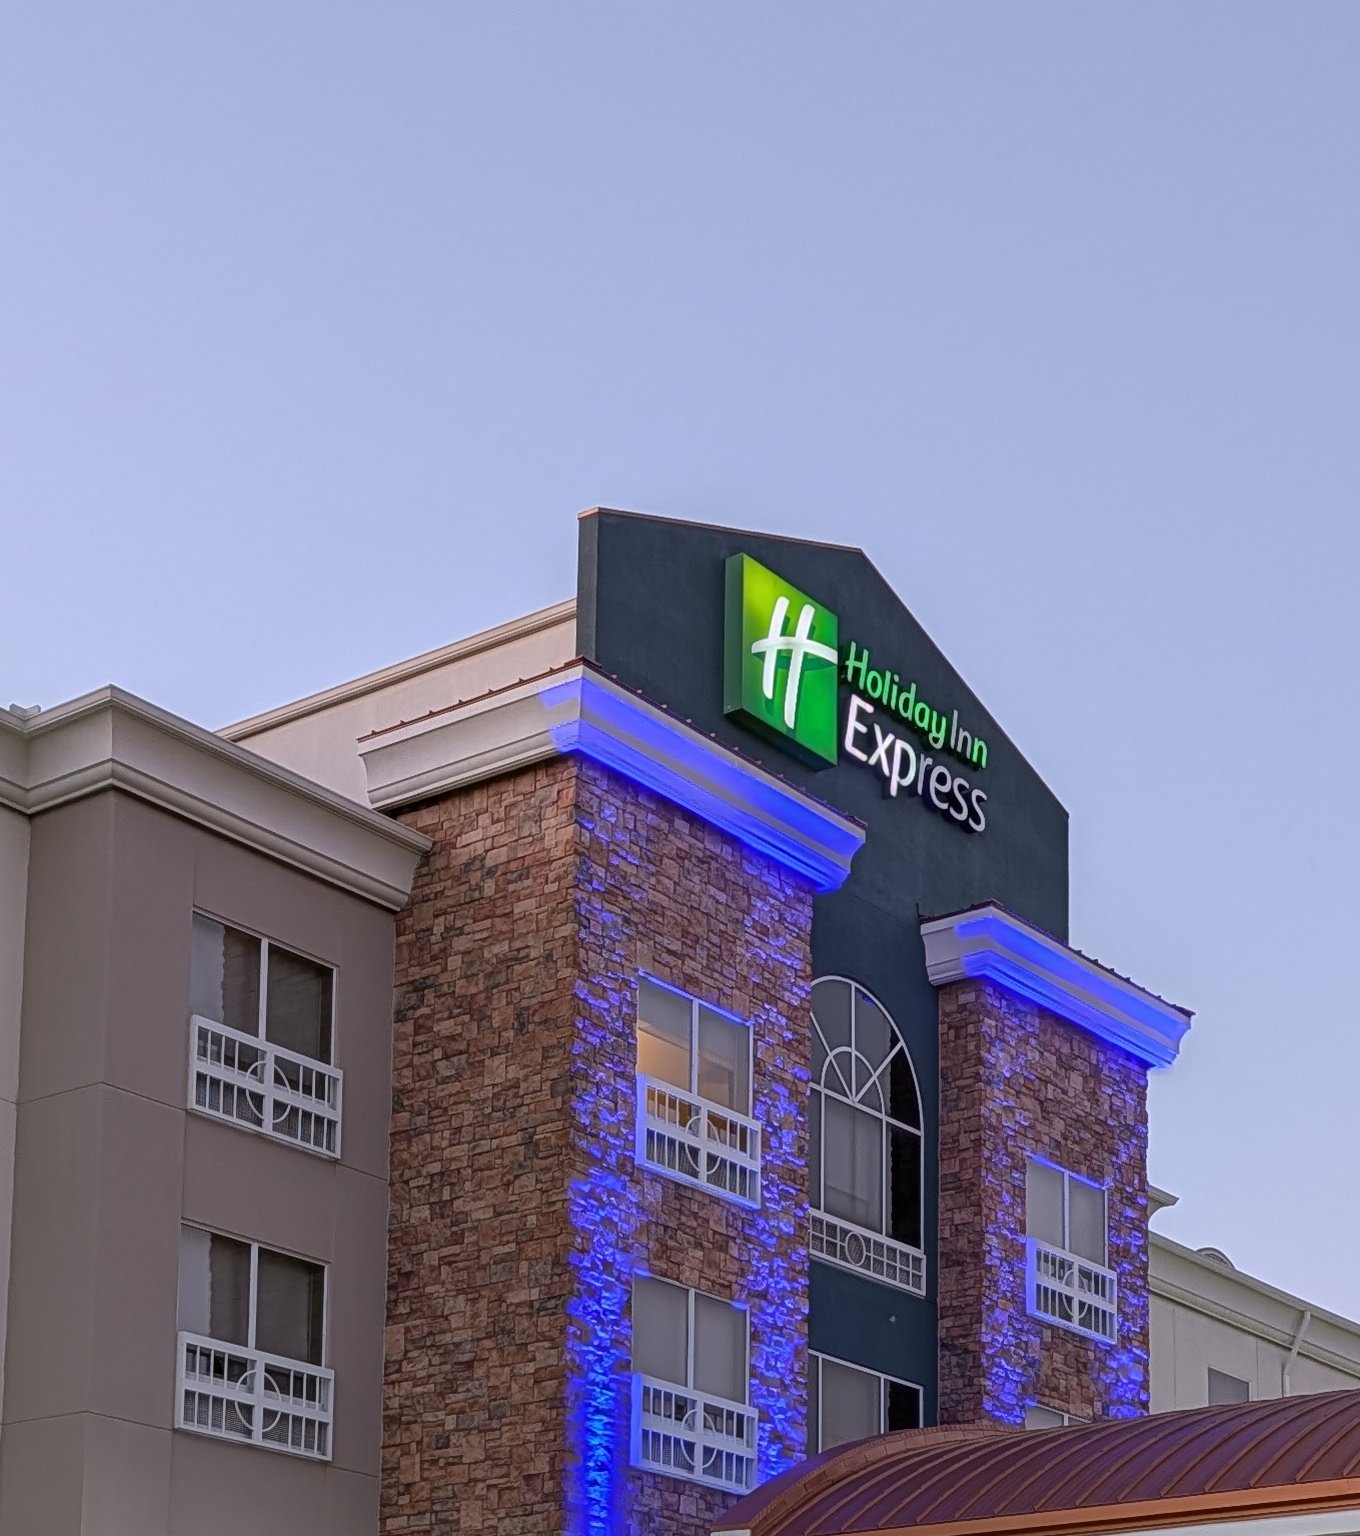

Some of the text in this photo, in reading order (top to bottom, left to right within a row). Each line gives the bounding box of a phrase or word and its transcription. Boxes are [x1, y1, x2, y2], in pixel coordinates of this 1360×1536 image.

[844, 693, 988, 832] Express
[845, 641, 988, 769] Holiday Inn
